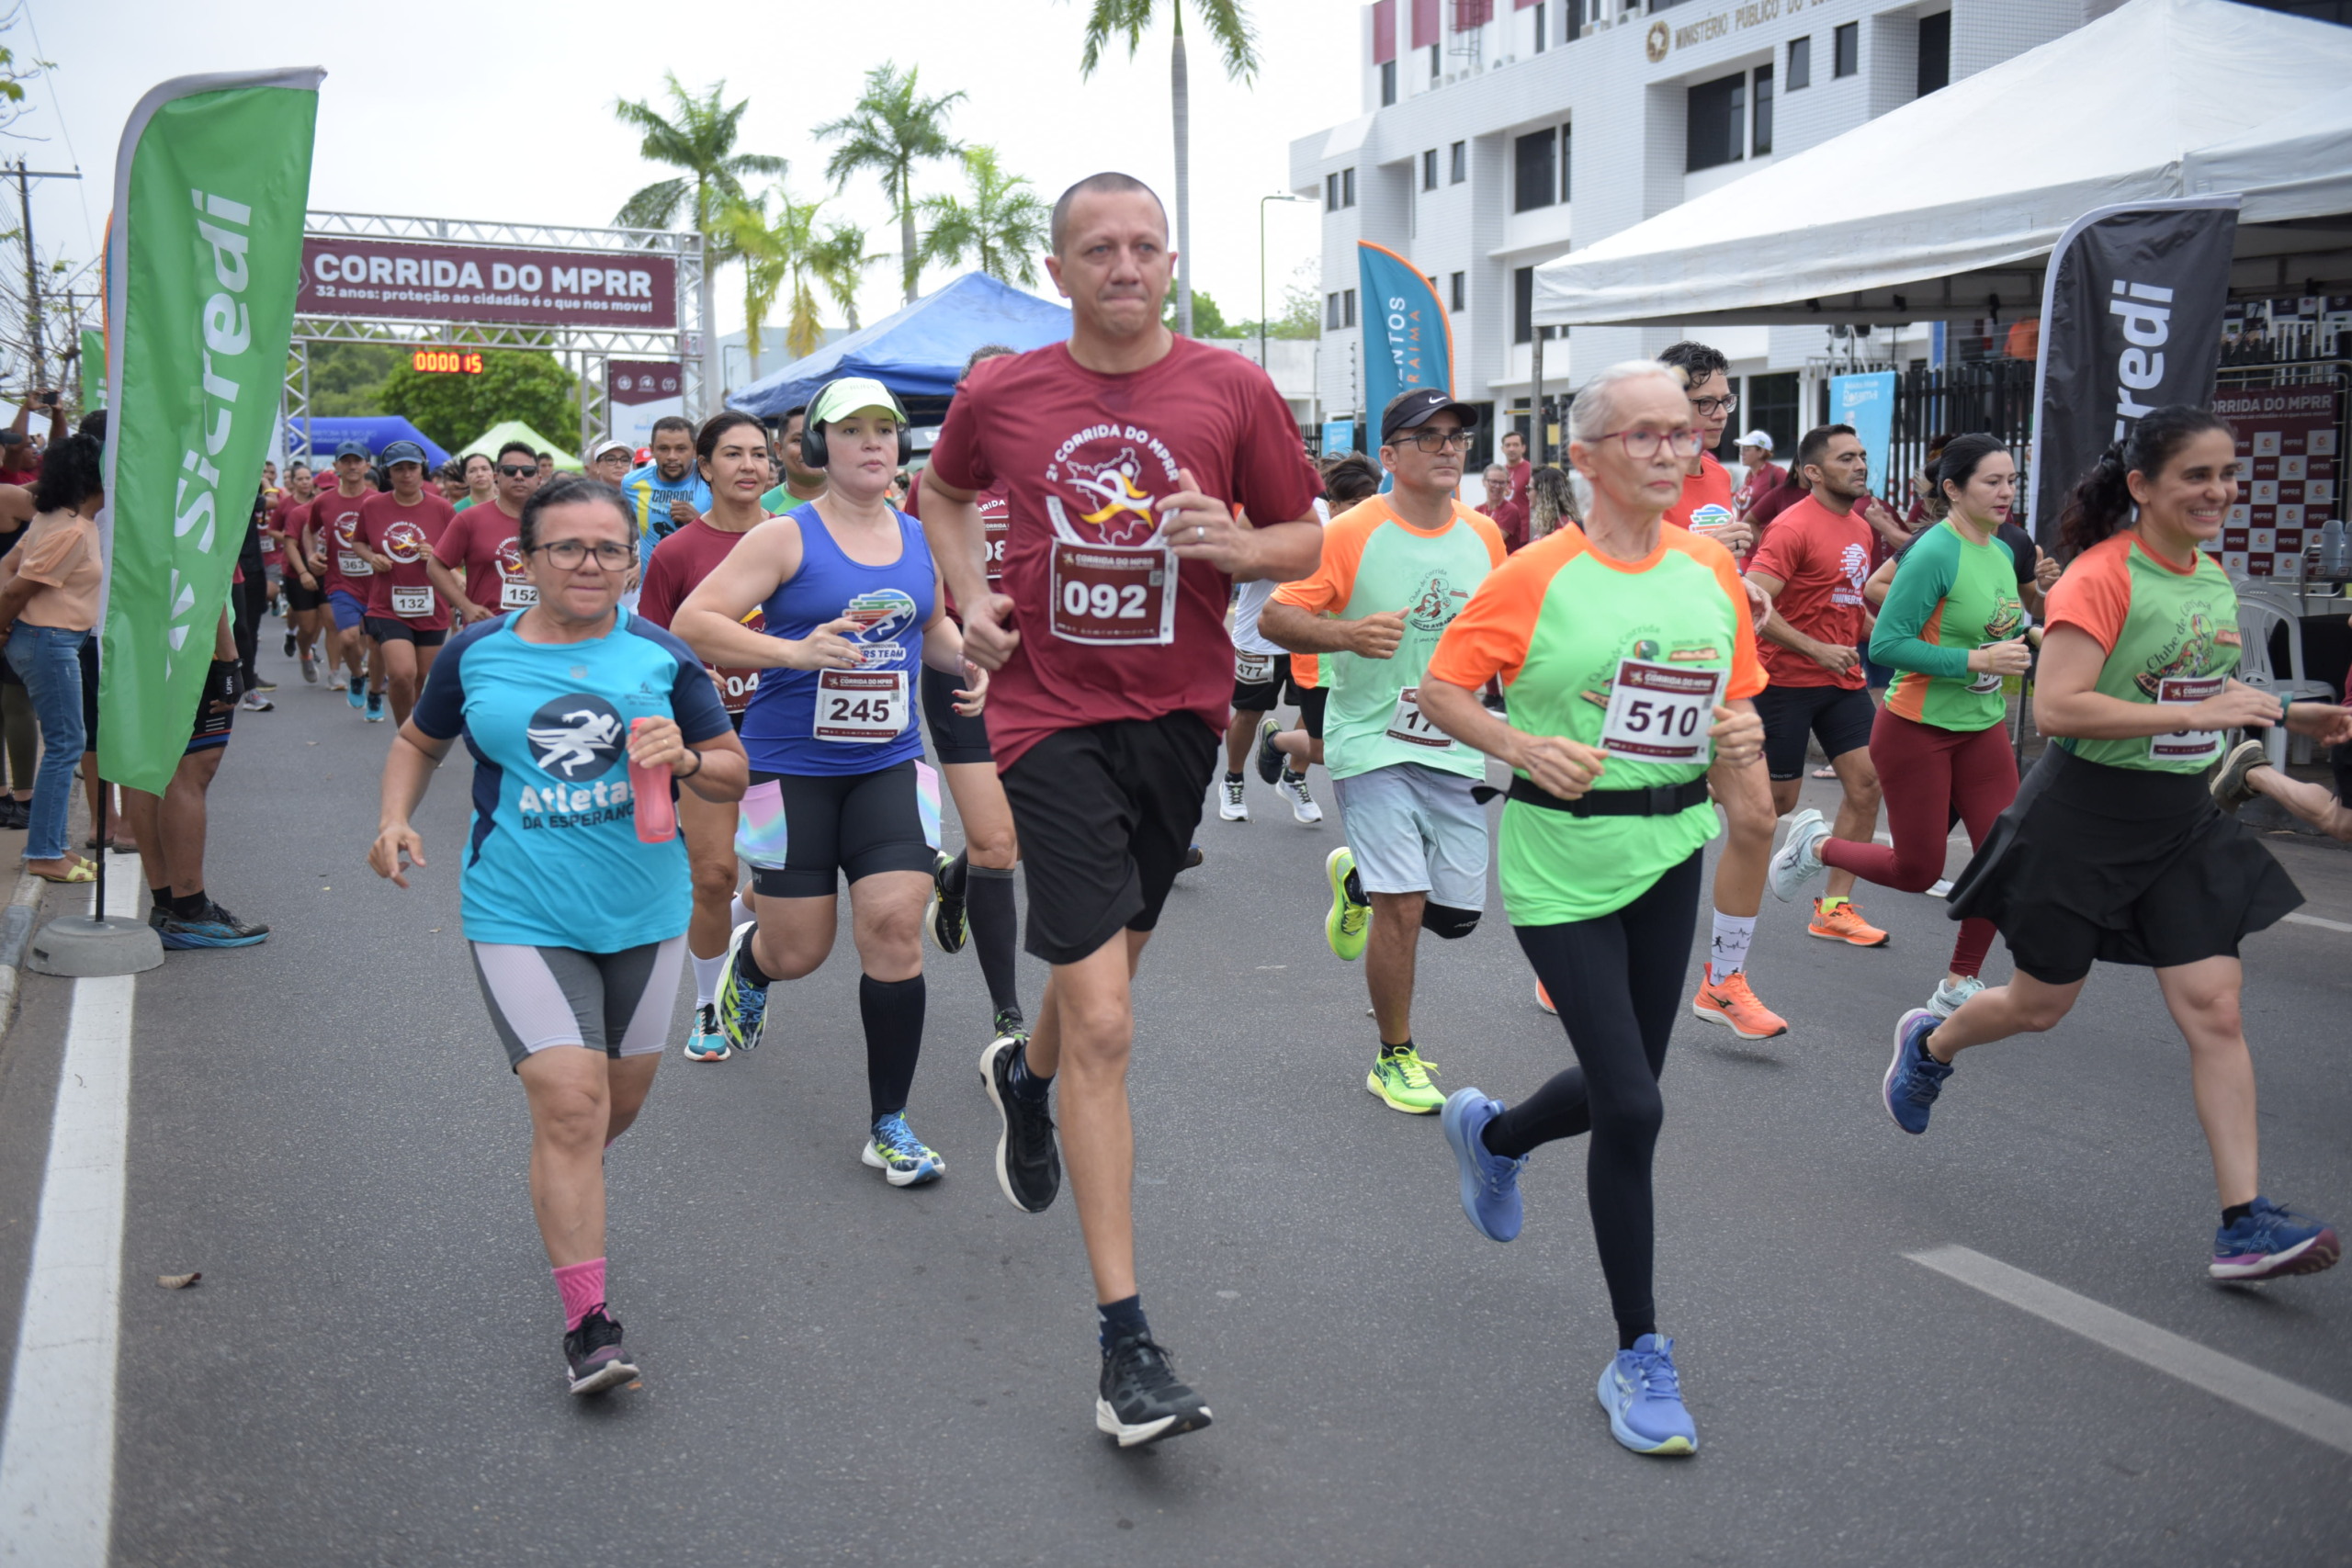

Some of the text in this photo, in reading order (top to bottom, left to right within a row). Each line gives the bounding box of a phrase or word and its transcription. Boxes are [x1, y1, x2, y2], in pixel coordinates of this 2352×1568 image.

[314, 253, 652, 298] CORRIDA DO MPRR
[316, 284, 653, 312] 32 anos: proteção ao cidadão é o que nos move!
[2109, 279, 2174, 430] redi
[175, 187, 252, 555] Sicredi
[2264, 398, 2285, 411] DO
[2288, 395, 2332, 410] MPRR
[1055, 424, 1121, 463] CORRIDA
[1125, 426, 1149, 444] DO
[1148, 437, 1180, 482] MPRR
[344, 560, 365, 570] 363
[399, 599, 425, 608] 132
[510, 588, 538, 602] 152
[1064, 581, 1148, 619] 092
[877, 649, 903, 659] TEAM
[2146, 637, 2180, 670] Clube
[2177, 618, 2187, 635] de
[1238, 663, 1263, 677] 477
[830, 698, 889, 722] 245
[1625, 700, 1699, 737] 510
[523, 815, 544, 830] DA
